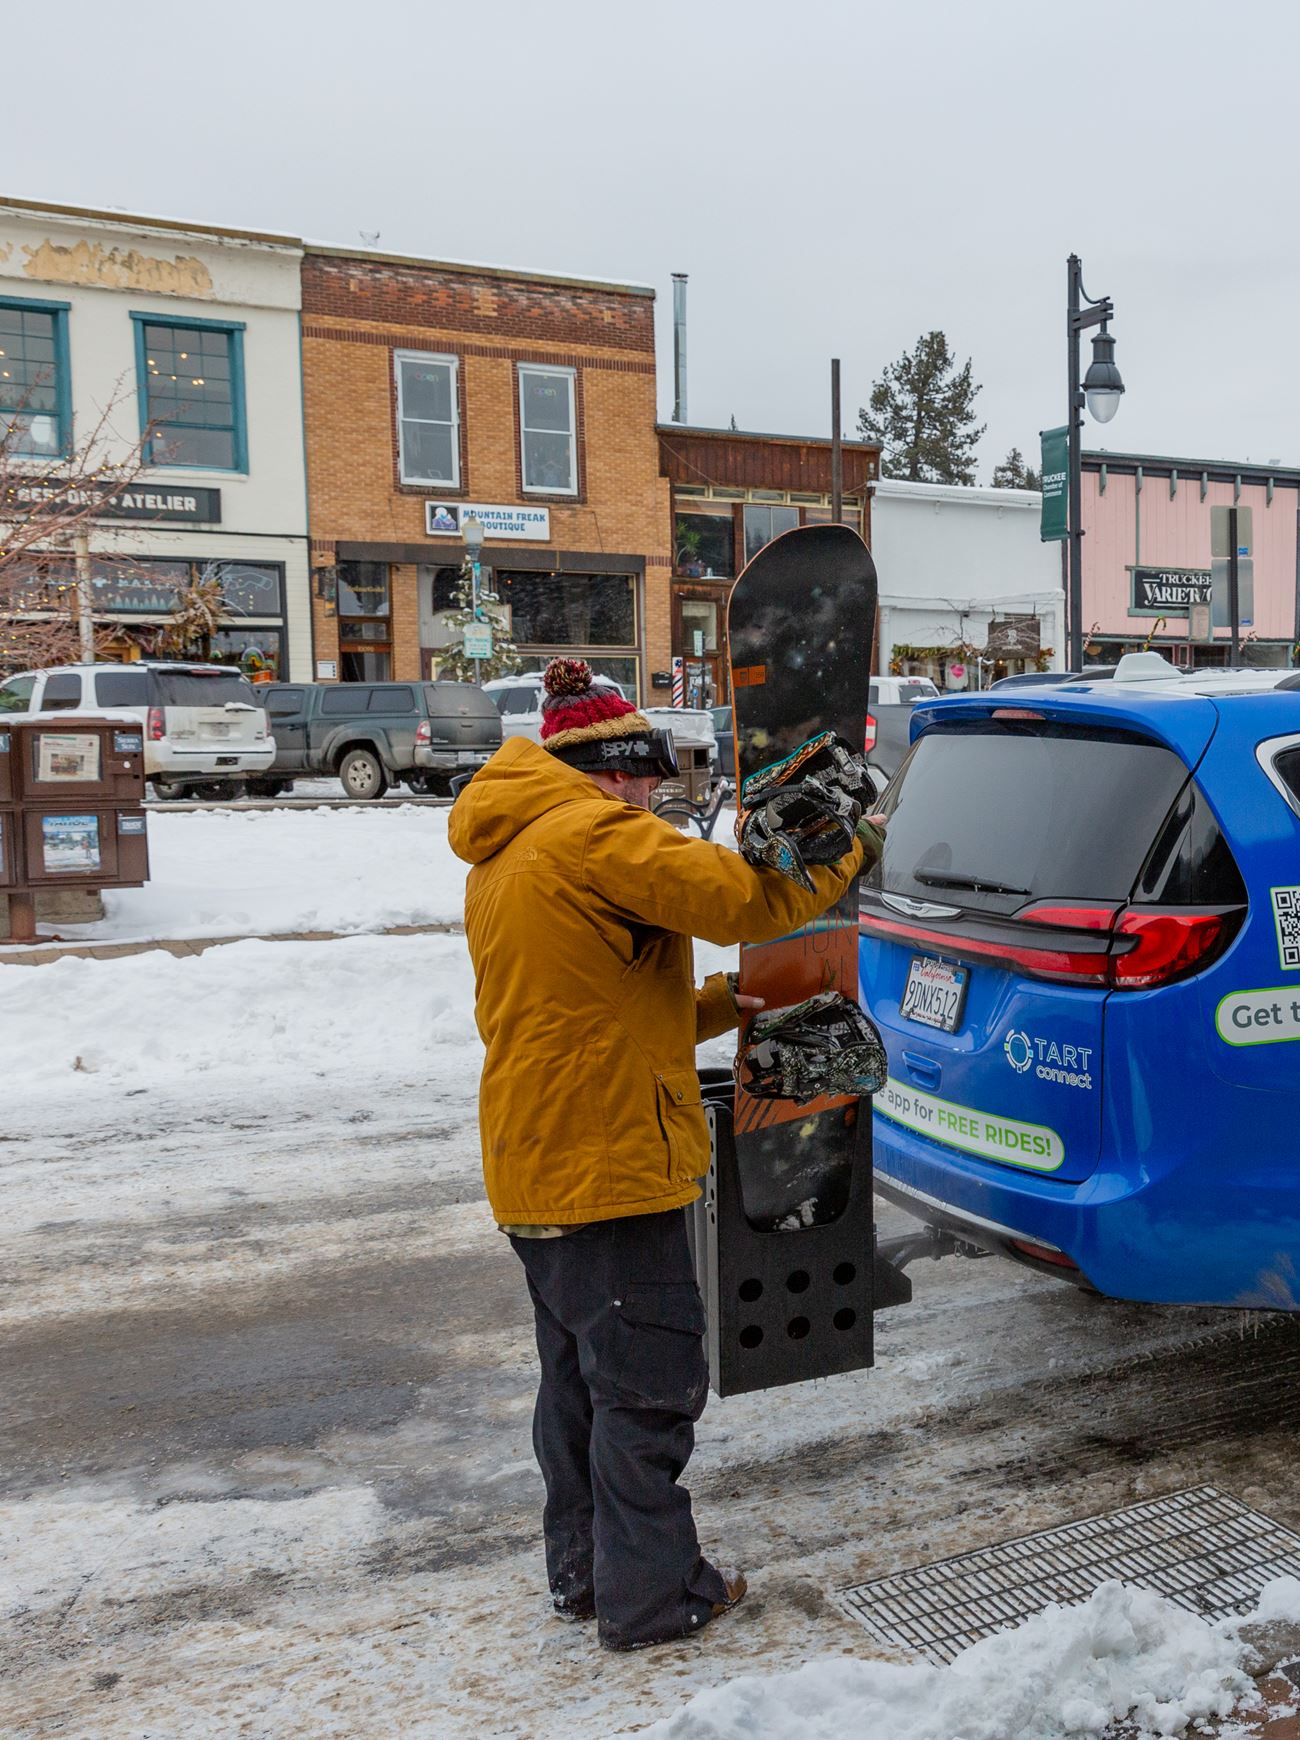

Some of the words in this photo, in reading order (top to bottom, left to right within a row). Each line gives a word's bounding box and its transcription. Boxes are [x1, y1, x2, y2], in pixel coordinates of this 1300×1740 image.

[122, 493, 197, 512] ATELIER
[516, 513, 546, 522] FREAK
[905, 979, 958, 1020] 9DNX512
[1232, 1003, 1283, 1029] Get
[1034, 1037, 1093, 1071] TART
[1036, 1065, 1092, 1090] connect
[888, 1088, 911, 1114] app
[914, 1099, 934, 1122] for
[938, 1109, 980, 1139] FREE
[985, 1123, 1052, 1157] RIDES!
